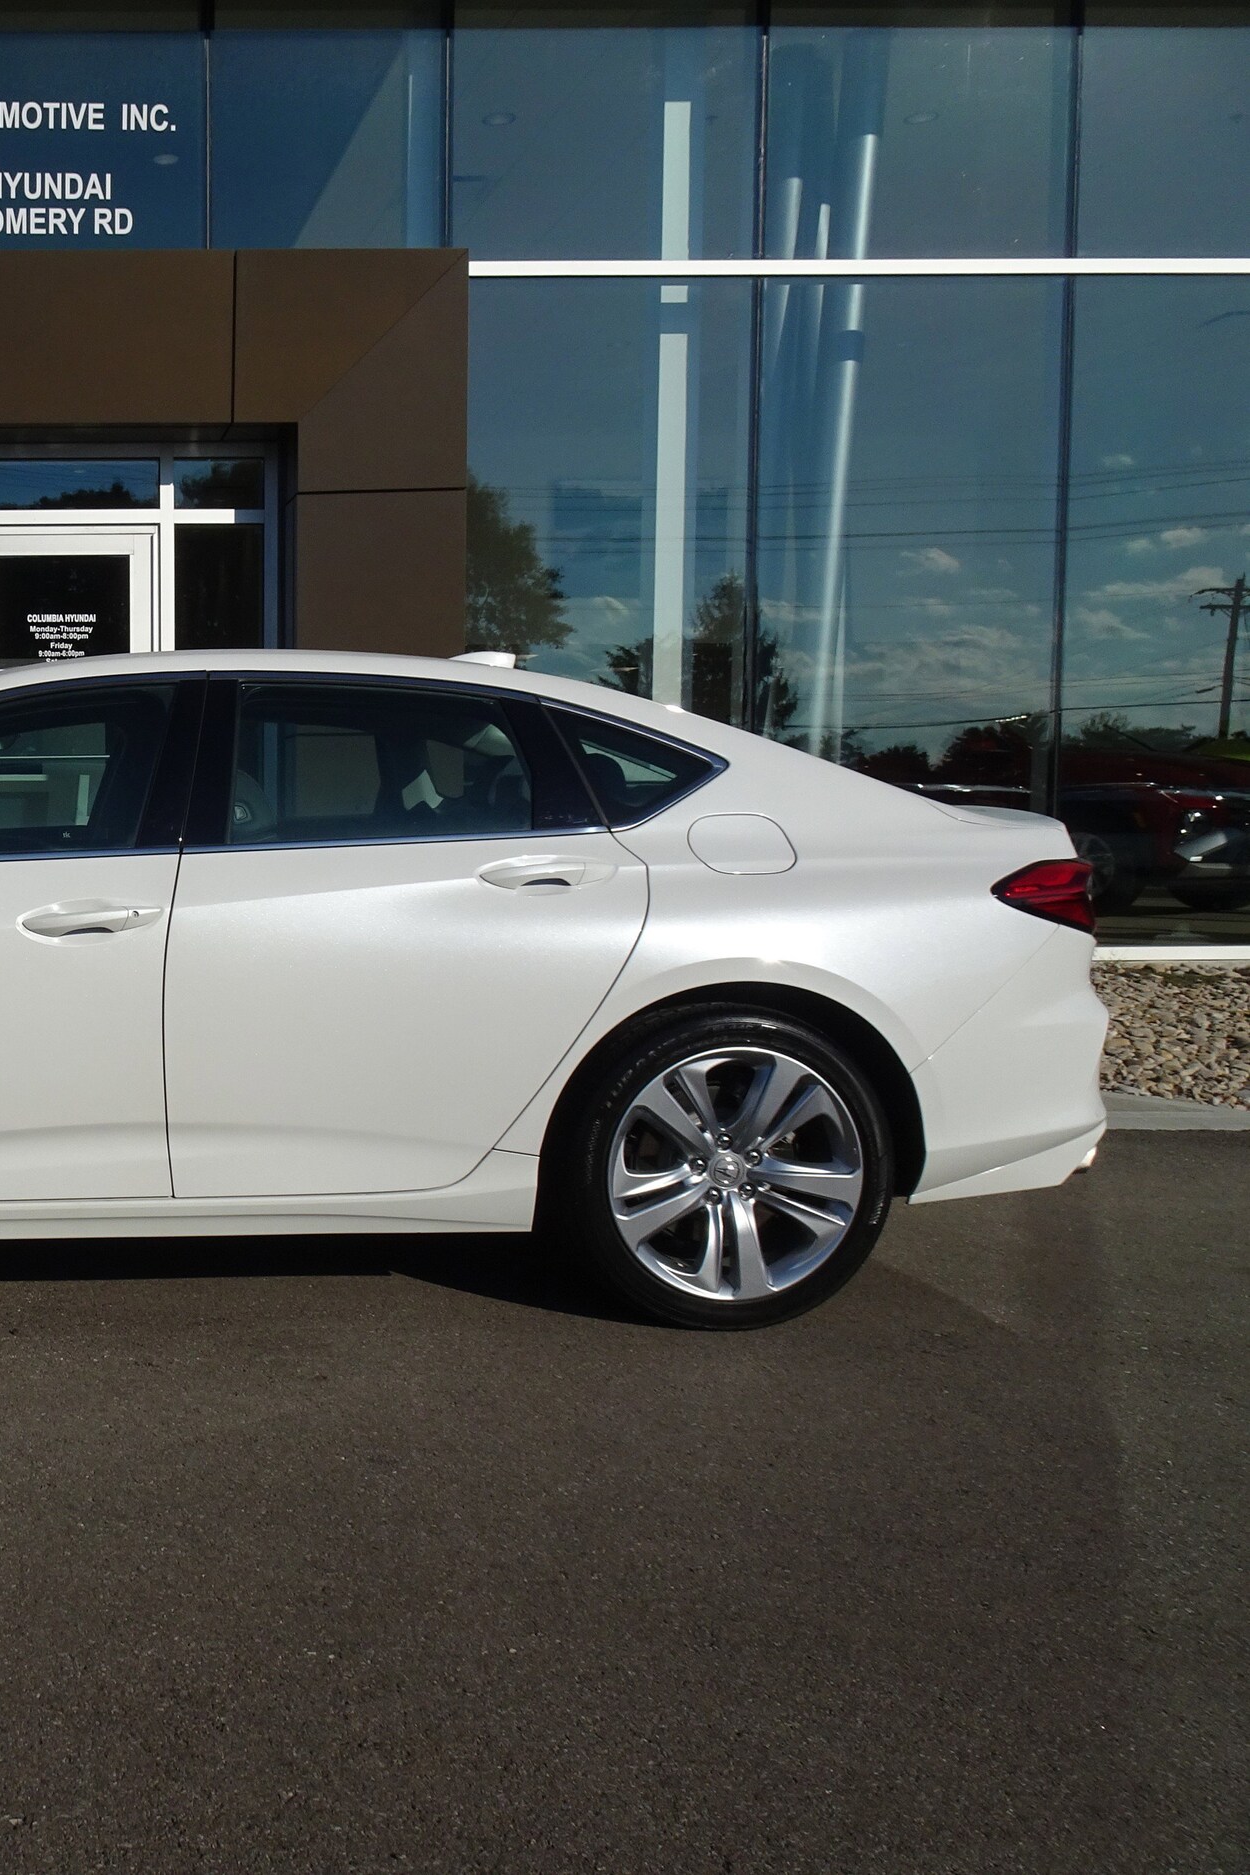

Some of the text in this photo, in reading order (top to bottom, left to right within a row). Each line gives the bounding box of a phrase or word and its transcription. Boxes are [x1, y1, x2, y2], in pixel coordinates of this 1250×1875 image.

[121, 103, 177, 132] INC.
[93, 207, 134, 235] RD
[27, 614, 96, 623] COLUMBIA HYUNDAI
[29, 625, 93, 634] Monday-Thursday
[34, 633, 89, 641] 9:00am-8:00pm
[50, 642, 73, 650] Friday
